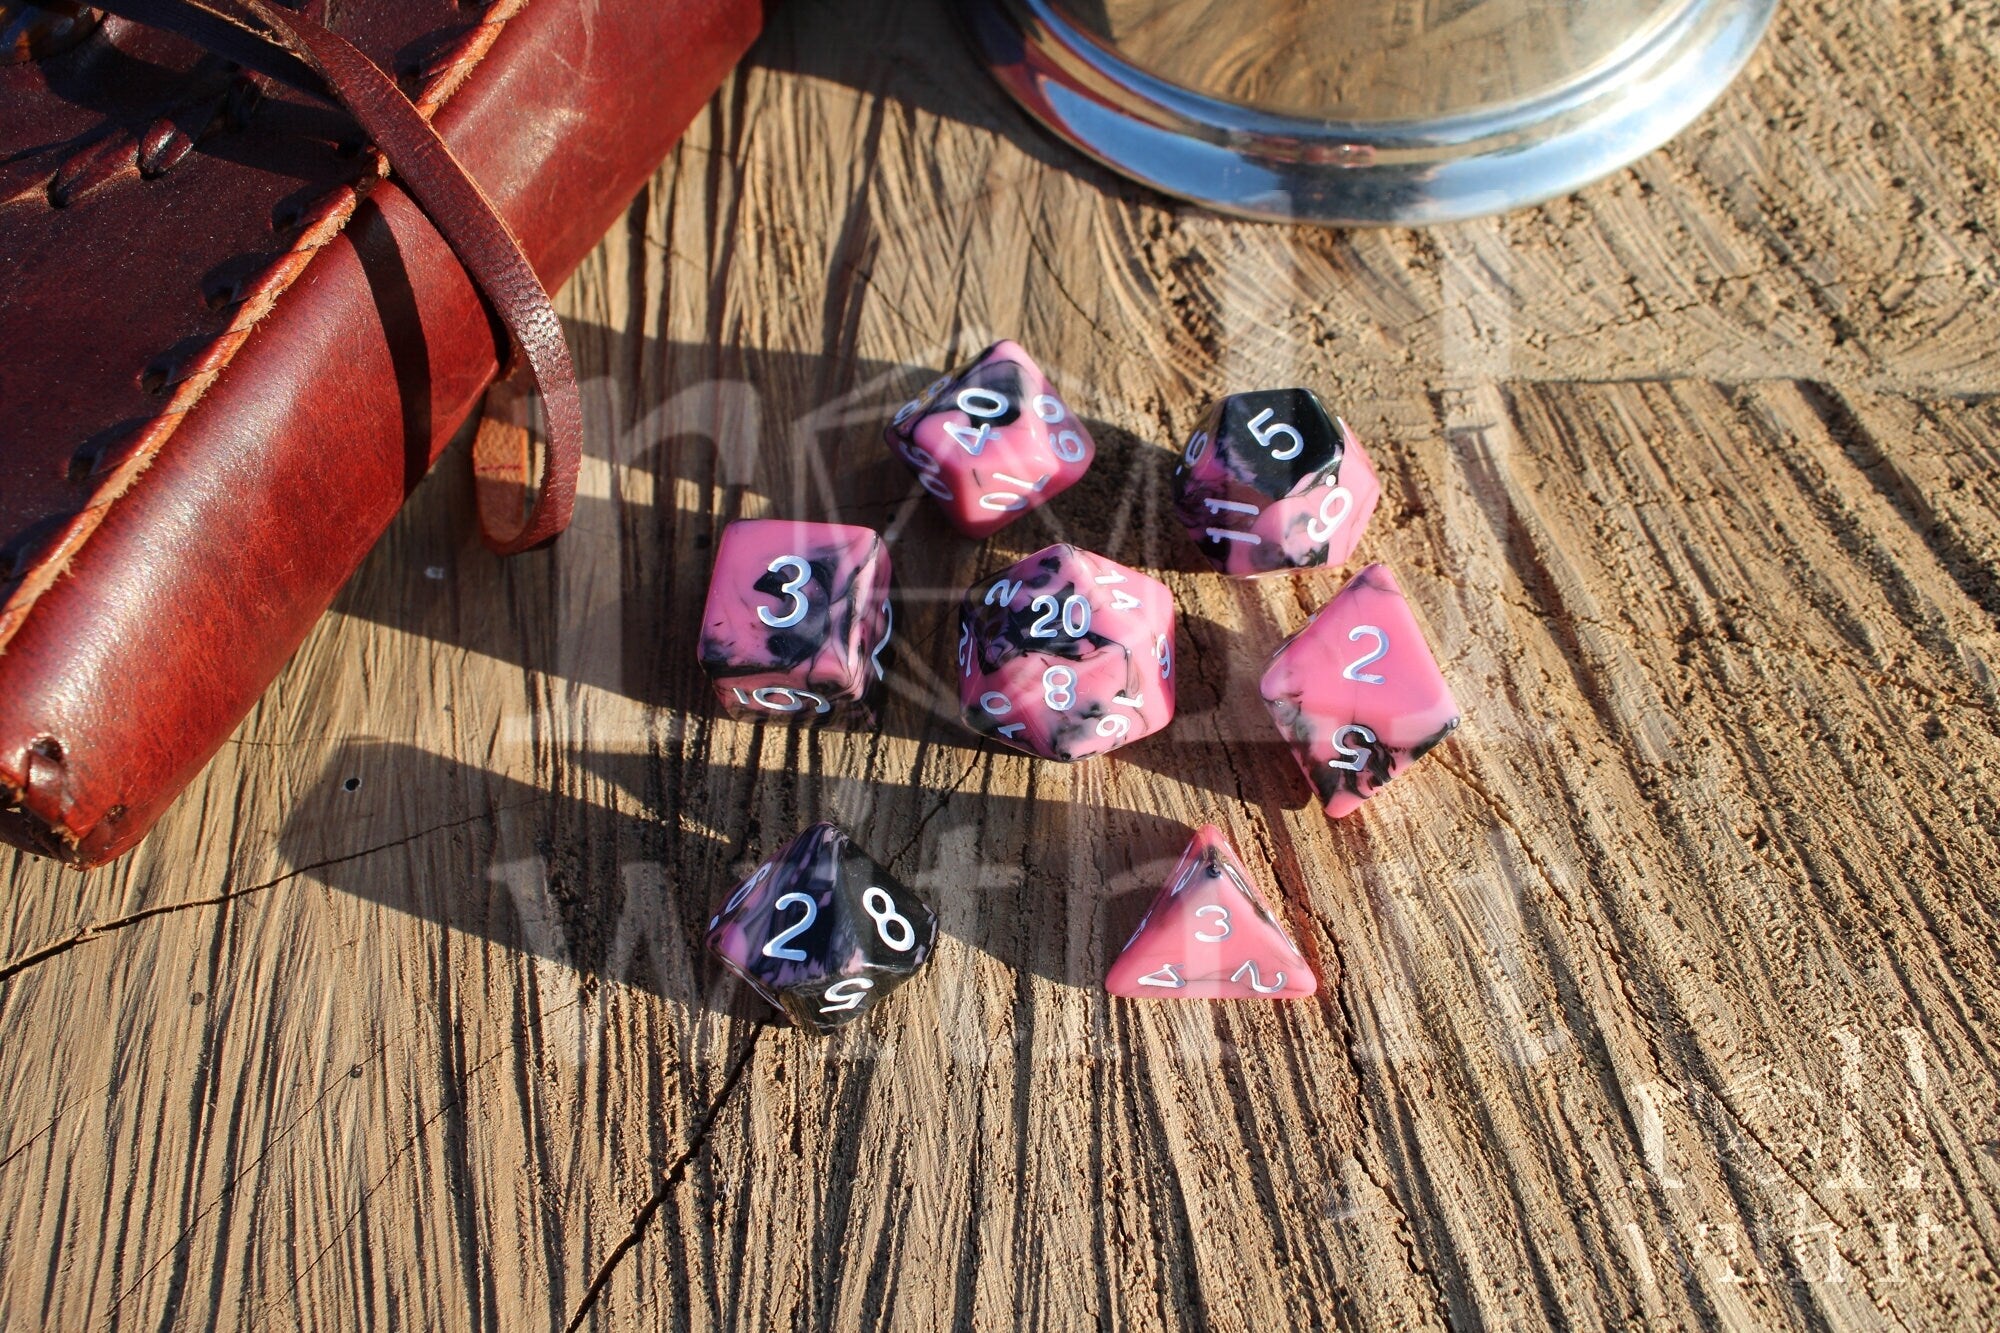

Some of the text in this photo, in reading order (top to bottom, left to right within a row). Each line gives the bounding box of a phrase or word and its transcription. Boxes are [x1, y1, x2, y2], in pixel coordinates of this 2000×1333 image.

[1247, 408, 1304, 460] 5
[1203, 498, 1261, 544] 11
[757, 555, 811, 628] 3
[985, 579, 1022, 607] 2
[1095, 570, 1144, 610] 14
[1030, 595, 1092, 638] 20
[1343, 625, 1389, 684] 2
[1043, 665, 1077, 711] 8
[980, 691, 1026, 739] 10
[1096, 693, 1144, 738] 16
[1329, 725, 1377, 771] 5
[763, 892, 817, 961] 2
[862, 887, 915, 951] 8
[1195, 905, 1232, 942] 3
[819, 977, 874, 1013] 5
[1137, 963, 1187, 988] 4
[1231, 960, 1287, 993] 2
